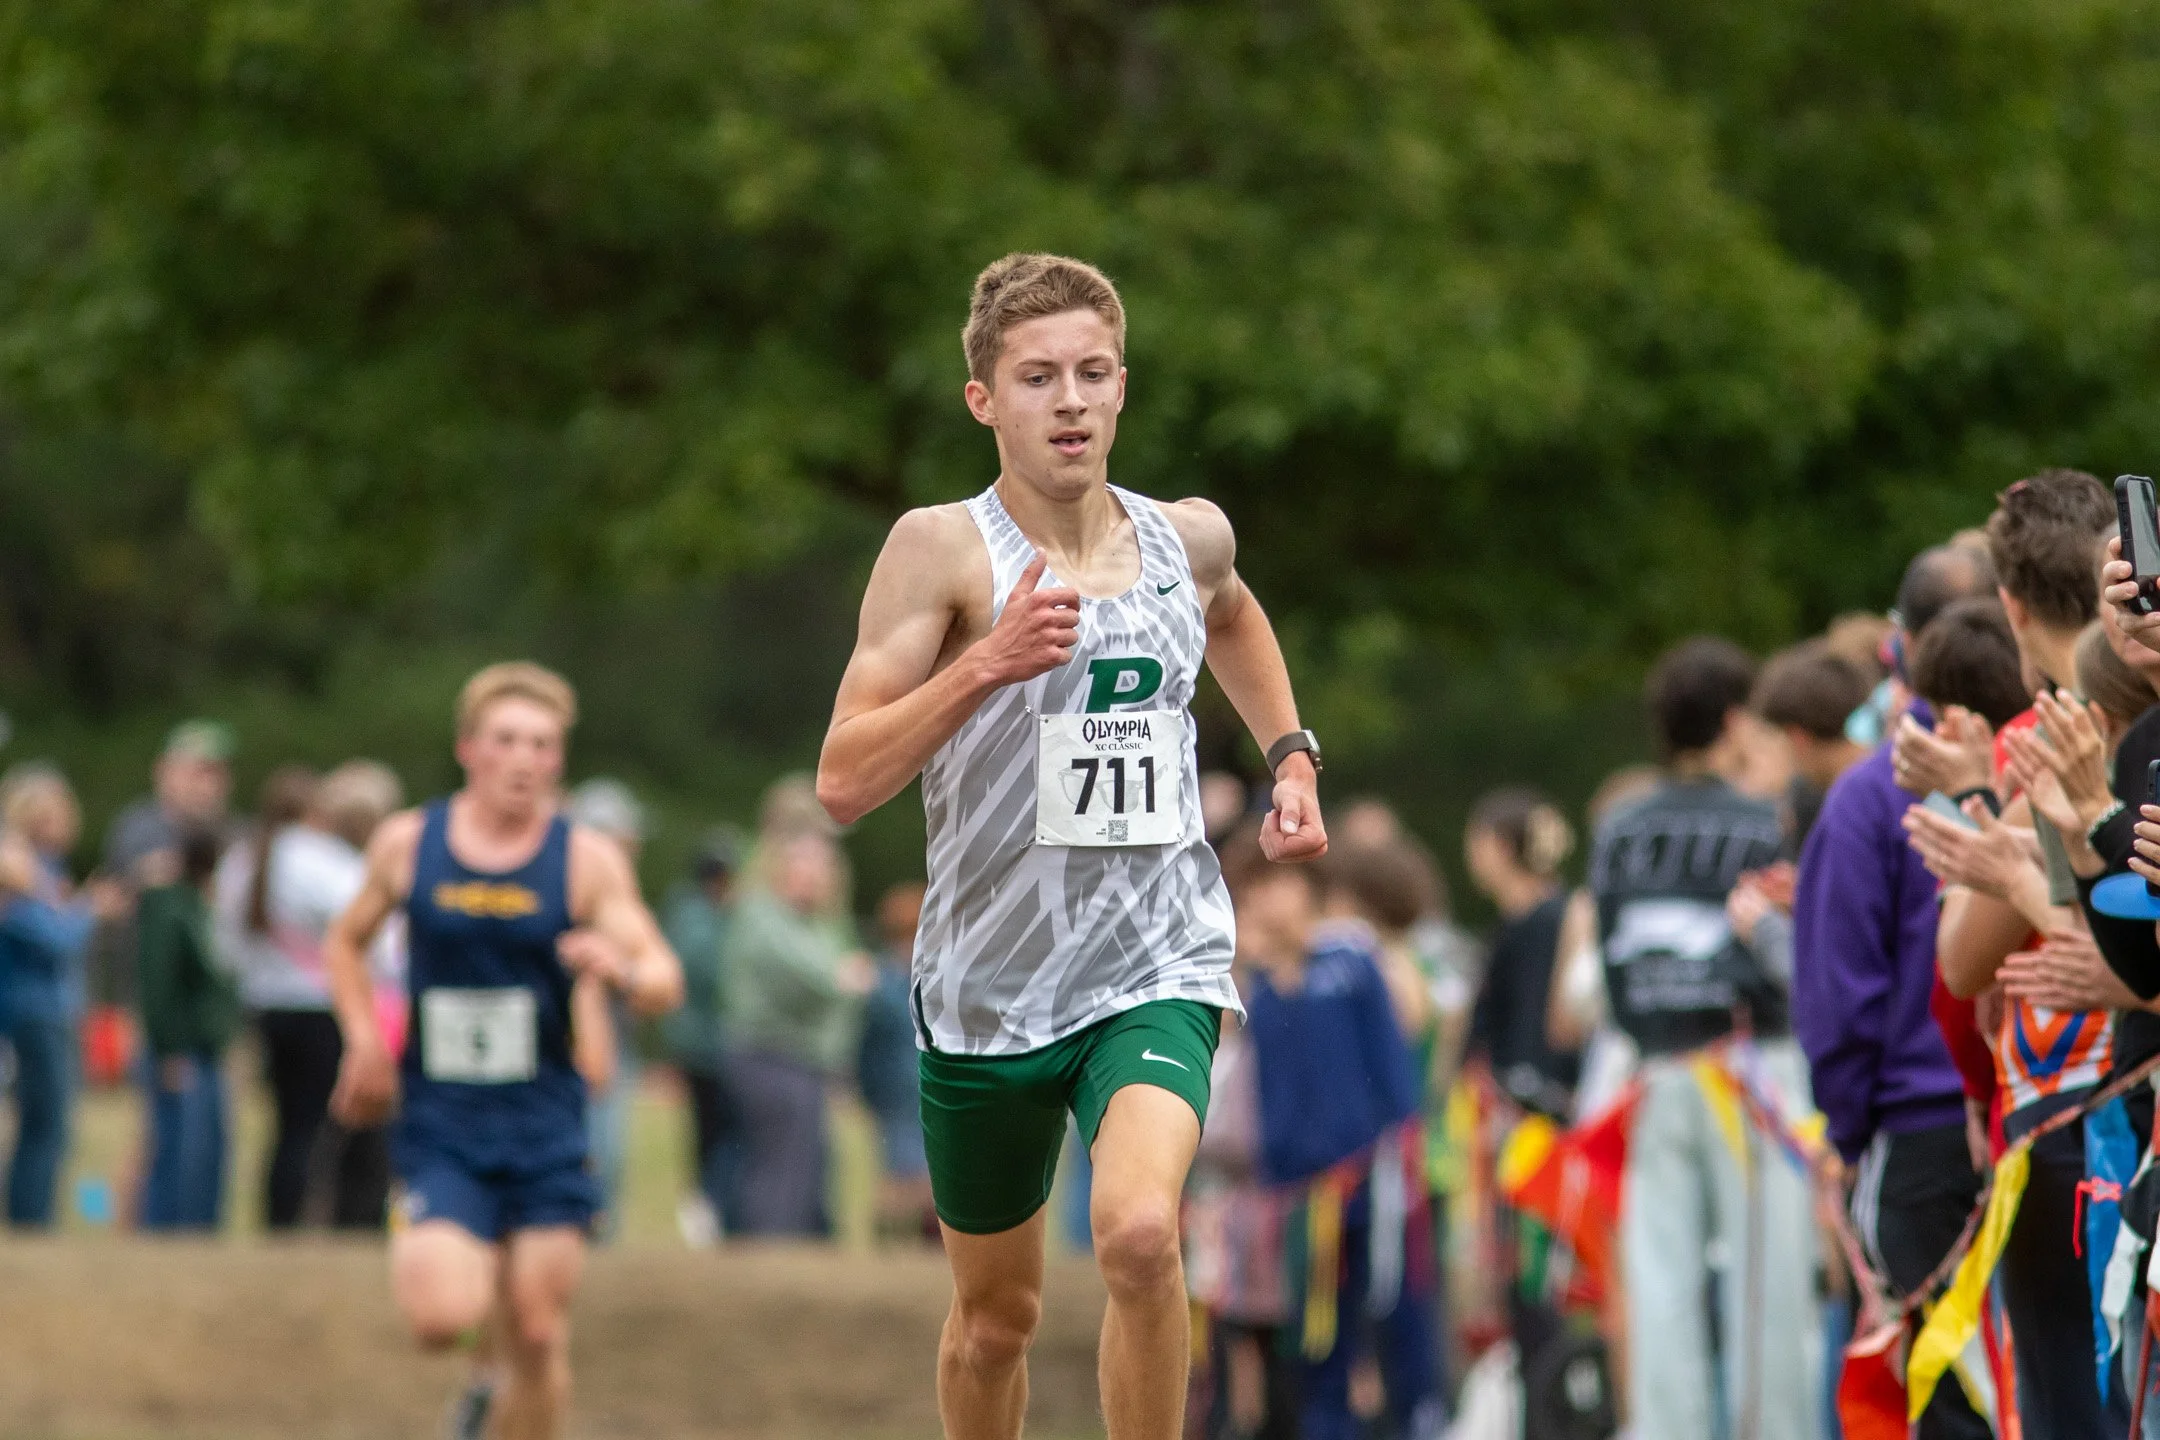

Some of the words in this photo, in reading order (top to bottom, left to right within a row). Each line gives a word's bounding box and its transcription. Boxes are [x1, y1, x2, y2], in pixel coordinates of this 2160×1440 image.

[1085, 656, 1164, 713] P
[1082, 716, 1152, 743] OLYMPIA
[1095, 743, 1108, 751] XC
[1108, 742, 1143, 751] CLASSIC
[1071, 756, 1155, 815] 711
